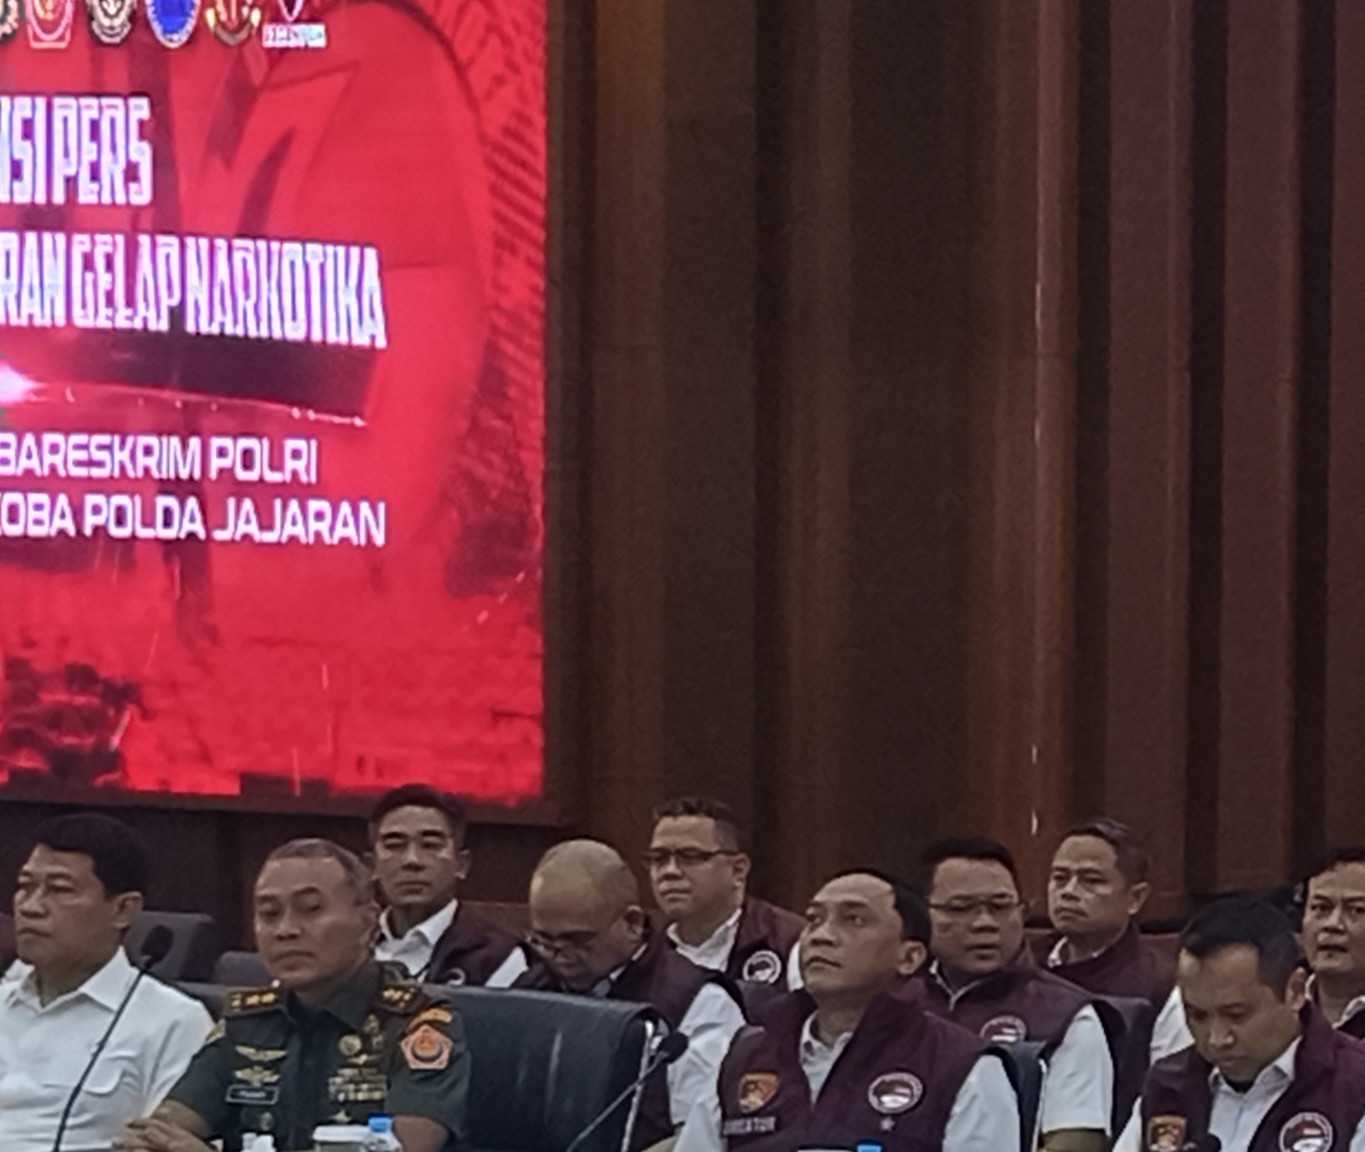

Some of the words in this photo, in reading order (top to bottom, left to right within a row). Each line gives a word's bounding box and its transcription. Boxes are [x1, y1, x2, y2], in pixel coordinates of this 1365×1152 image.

[52, 96, 153, 206] PERS
[71, 233, 183, 331] GELAP
[185, 237, 387, 348] NARKOTIKA
[0, 431, 201, 480] BARESKRIM
[208, 435, 318, 484] POLRI
[0, 491, 76, 538] OBA
[83, 493, 206, 541] POLDA
[211, 496, 386, 547] JAJARAN
